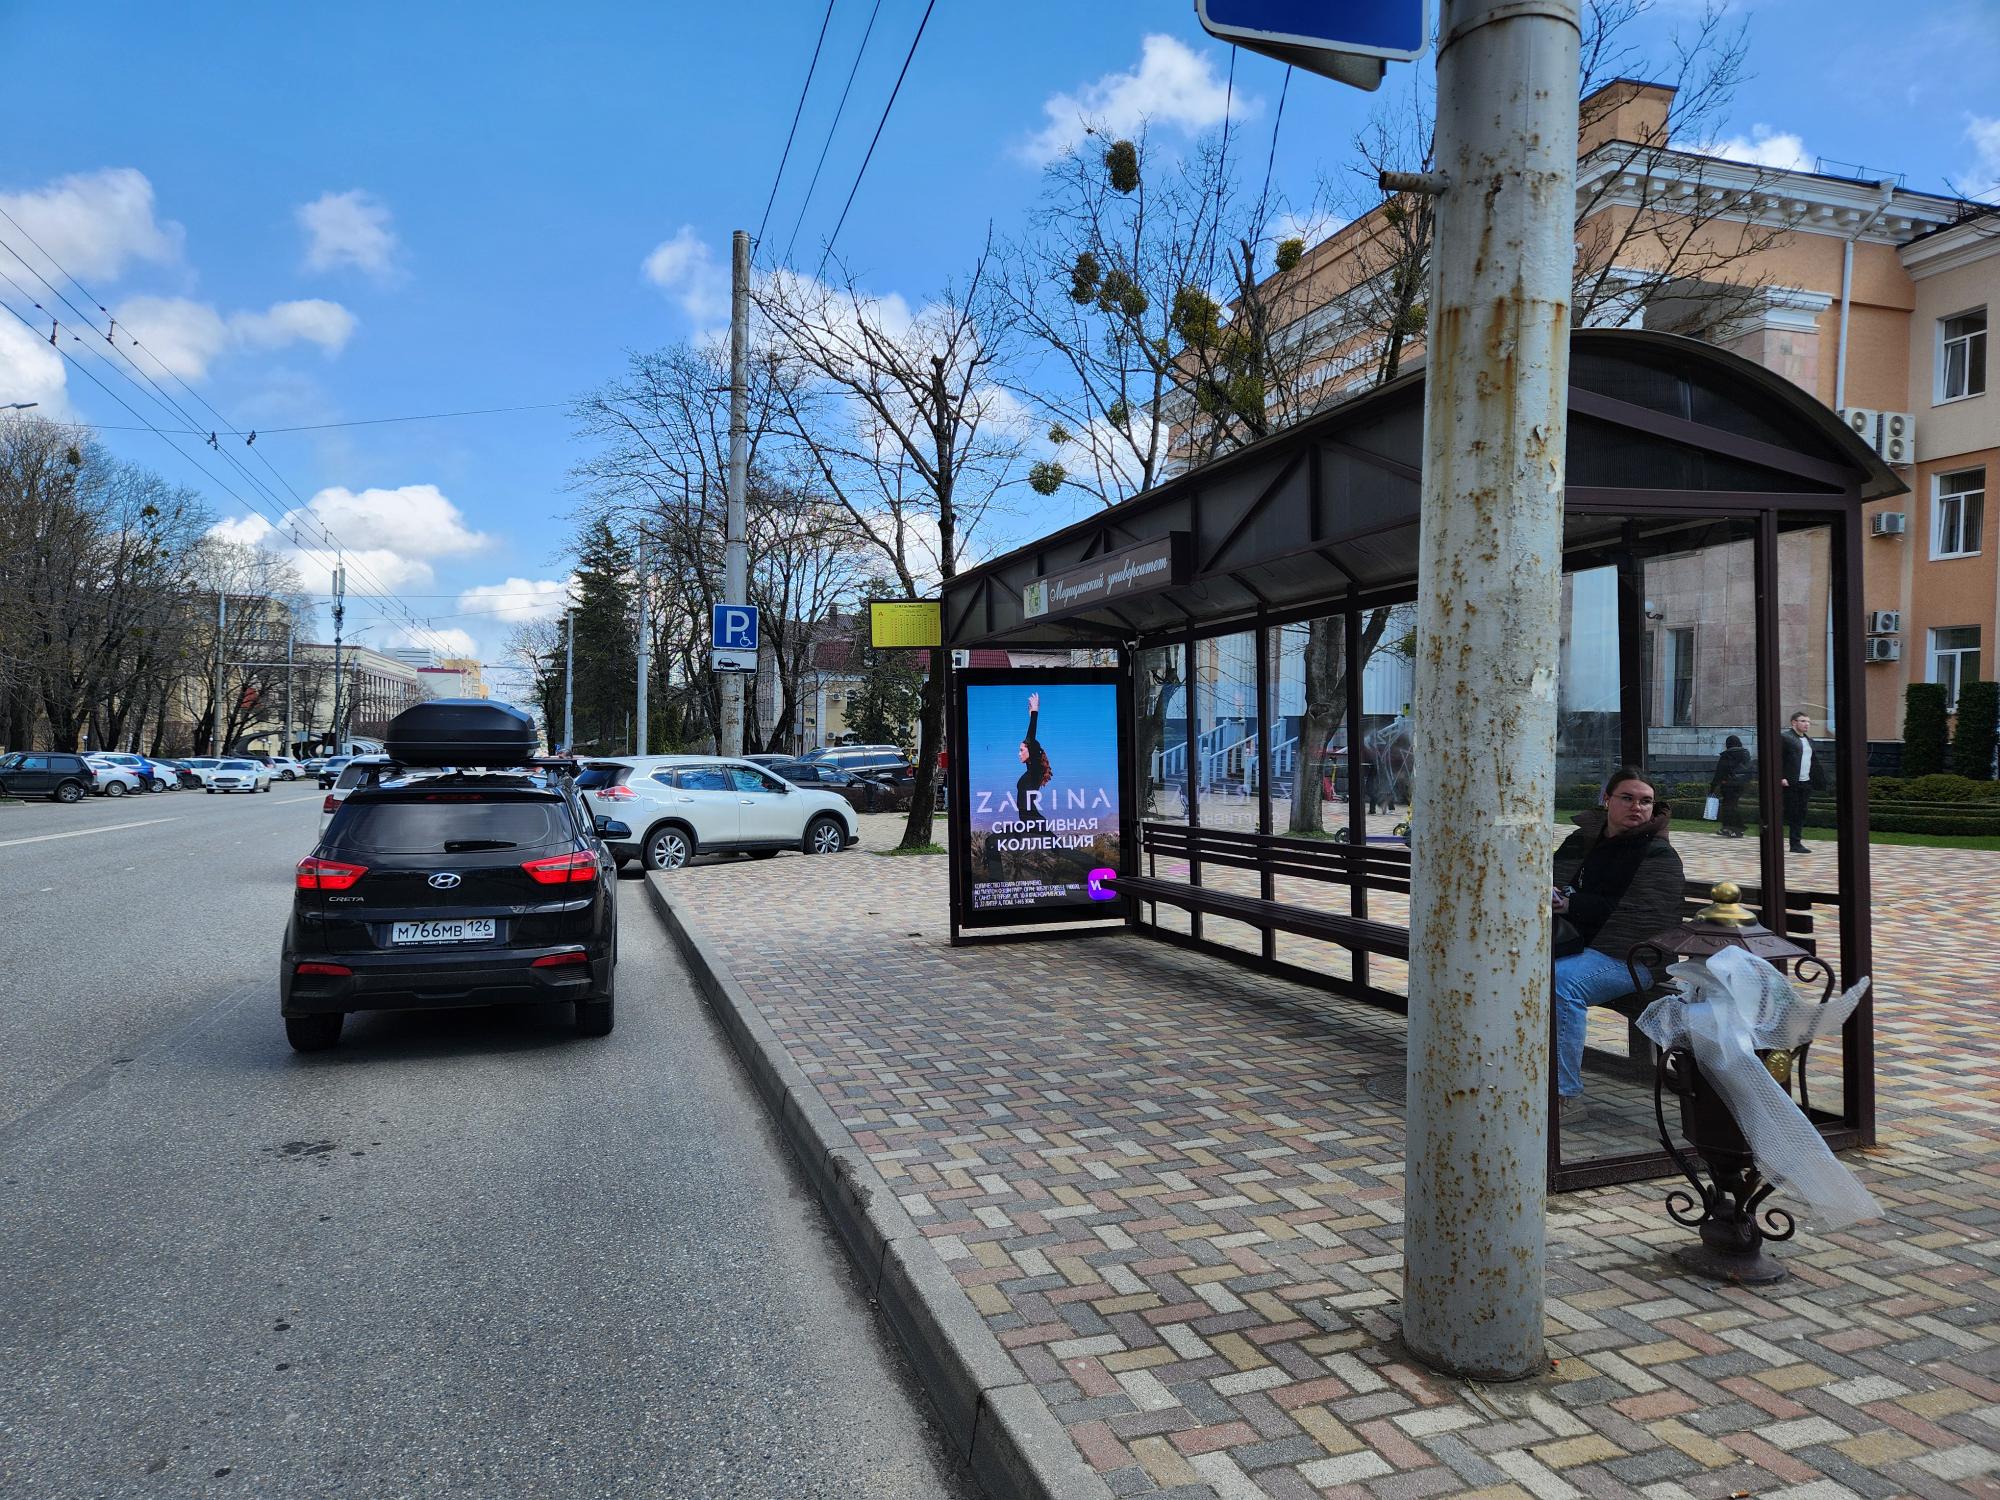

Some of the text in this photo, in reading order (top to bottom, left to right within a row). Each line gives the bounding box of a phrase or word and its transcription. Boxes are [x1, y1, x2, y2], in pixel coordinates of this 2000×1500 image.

[1050, 555, 1168, 607] Медицинский университет
[726, 610, 749, 643] P
[976, 788, 1112, 813] ZARINA
[992, 818, 1098, 834] СПОРТИВНАЯ
[998, 835, 1094, 851] КОЛЛЕКЦИЯ
[467, 920, 490, 932] 126
